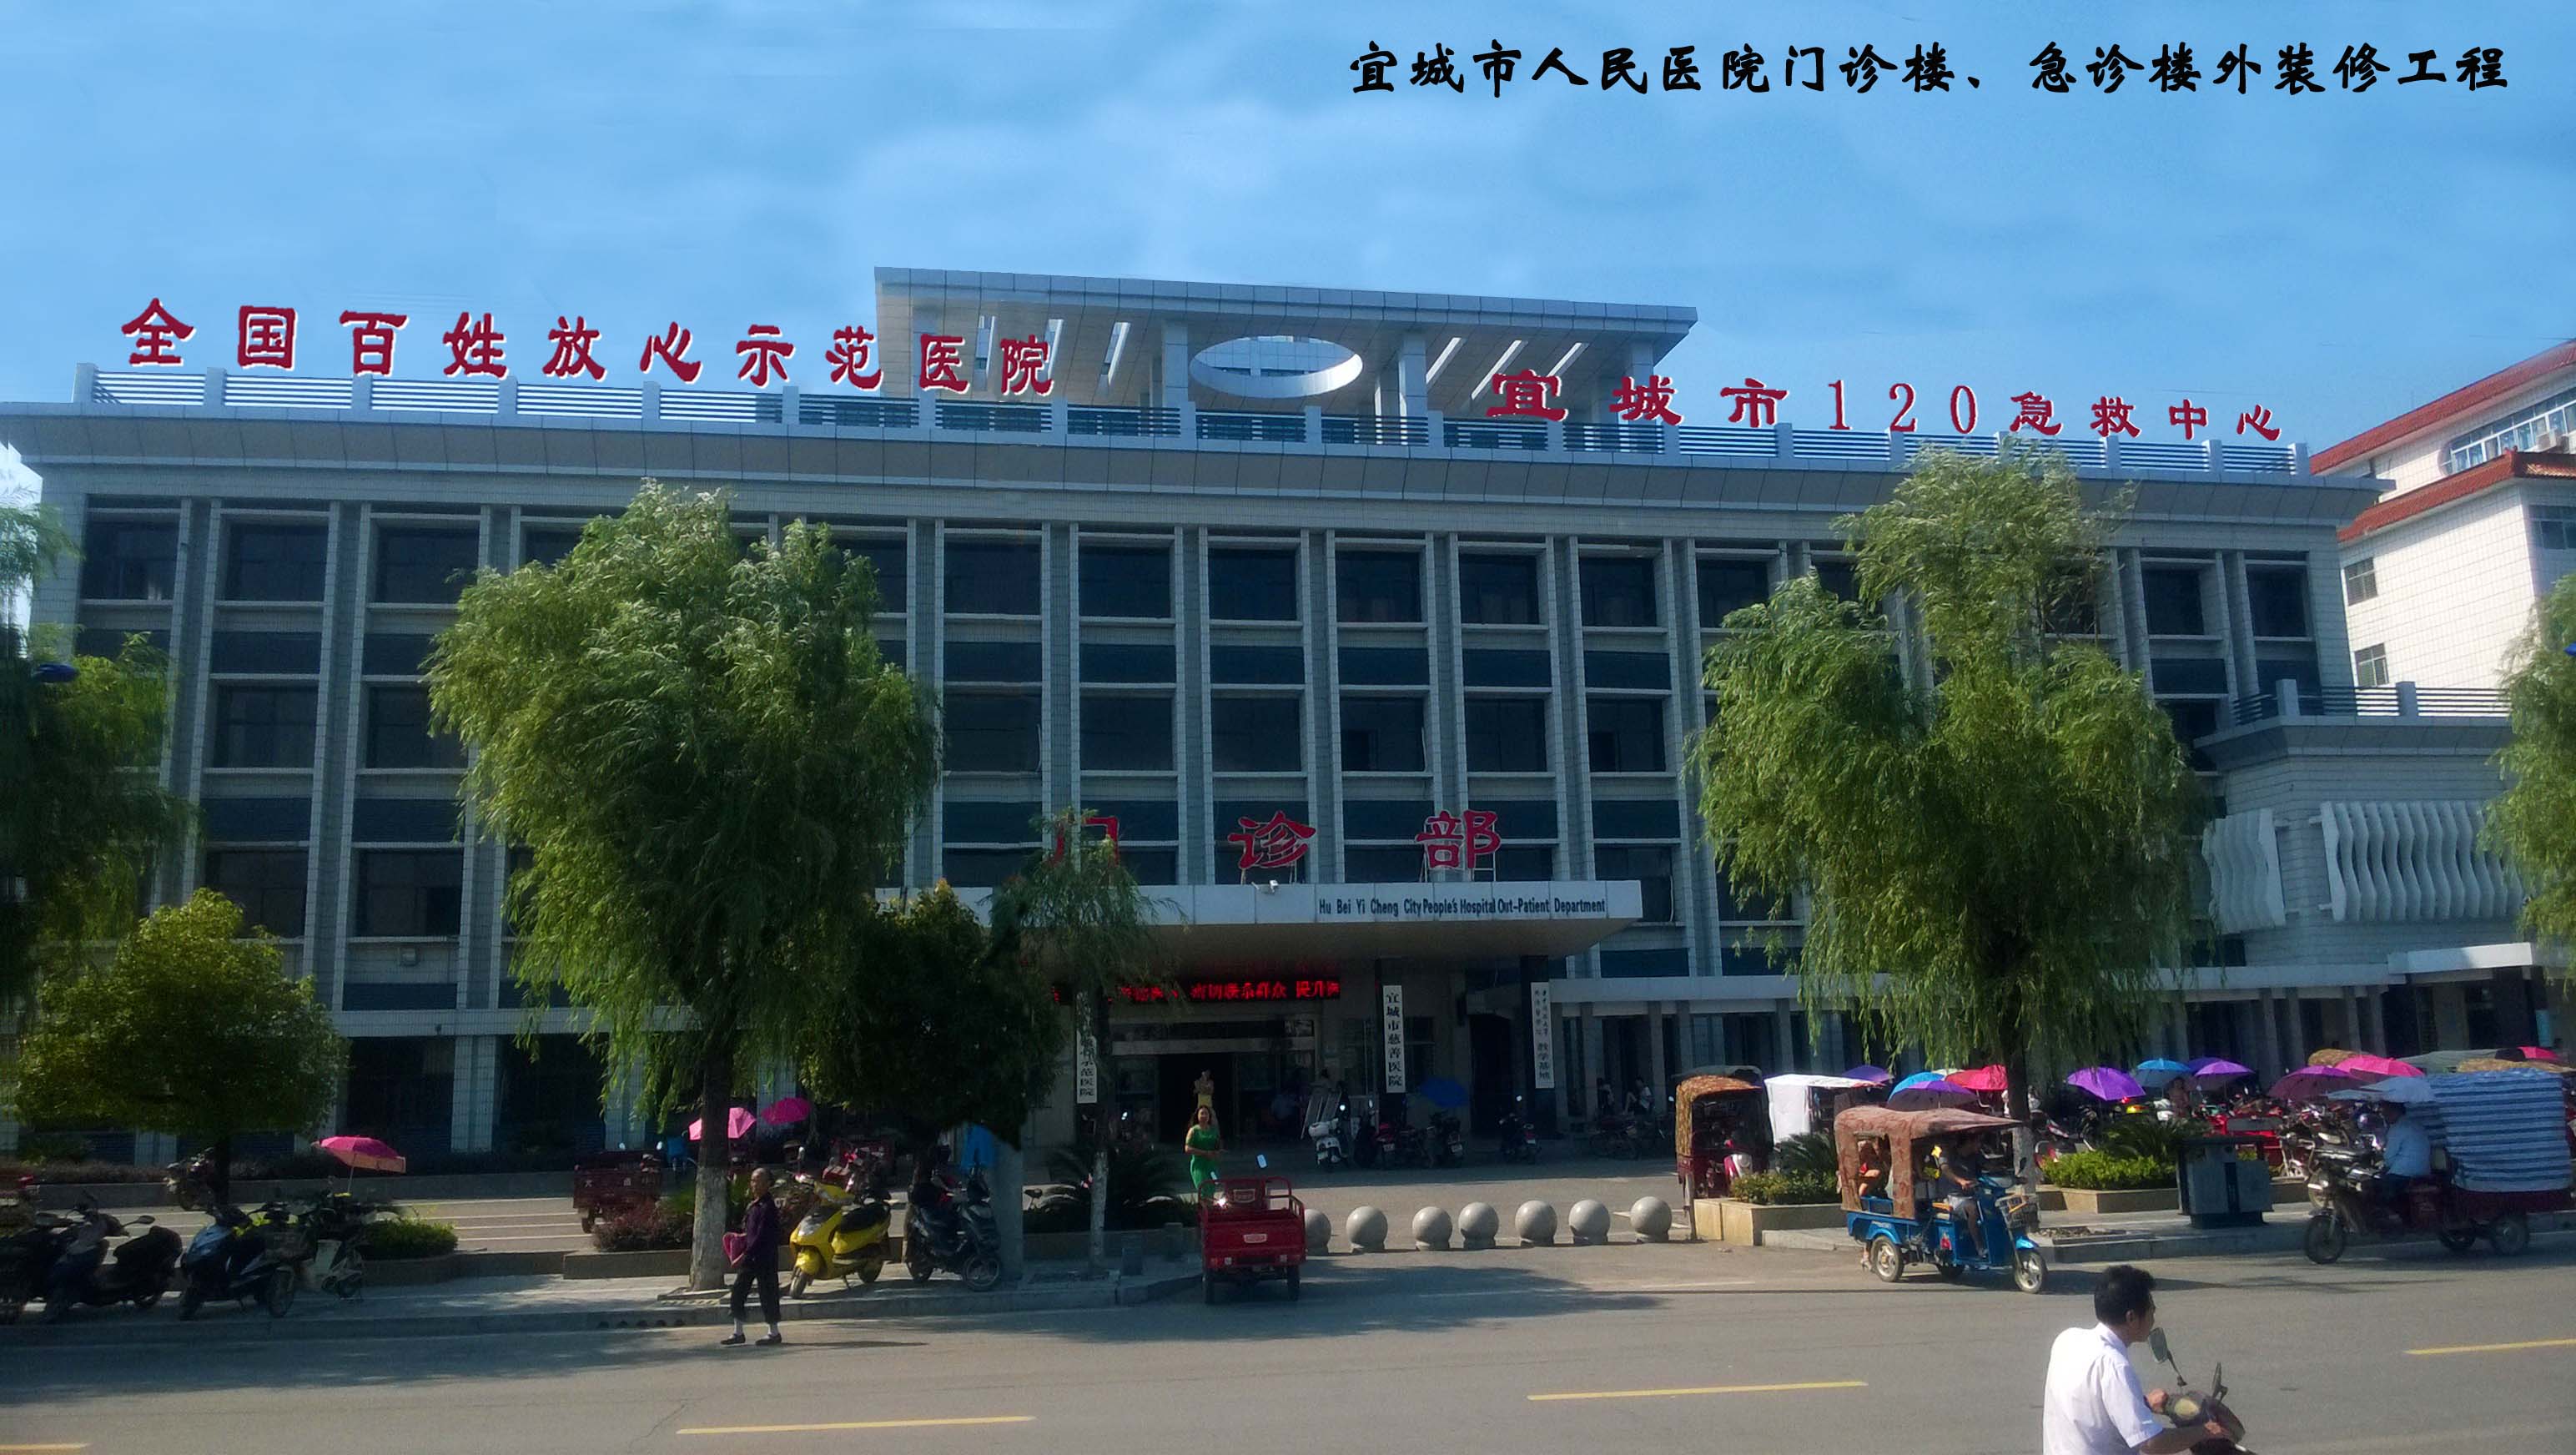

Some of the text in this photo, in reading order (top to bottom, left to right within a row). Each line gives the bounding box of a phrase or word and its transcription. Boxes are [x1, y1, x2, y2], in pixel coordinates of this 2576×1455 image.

[121, 297, 1054, 395] 全国百姓放心示范医院
[1486, 369, 2282, 441] 宜城市120急救中心
[1318, 897, 1604, 918] Hu Bei Yi Cheng City People's Hospital Out-Patient Department
[1386, 992, 1402, 1087] 宜城市慈善医院
